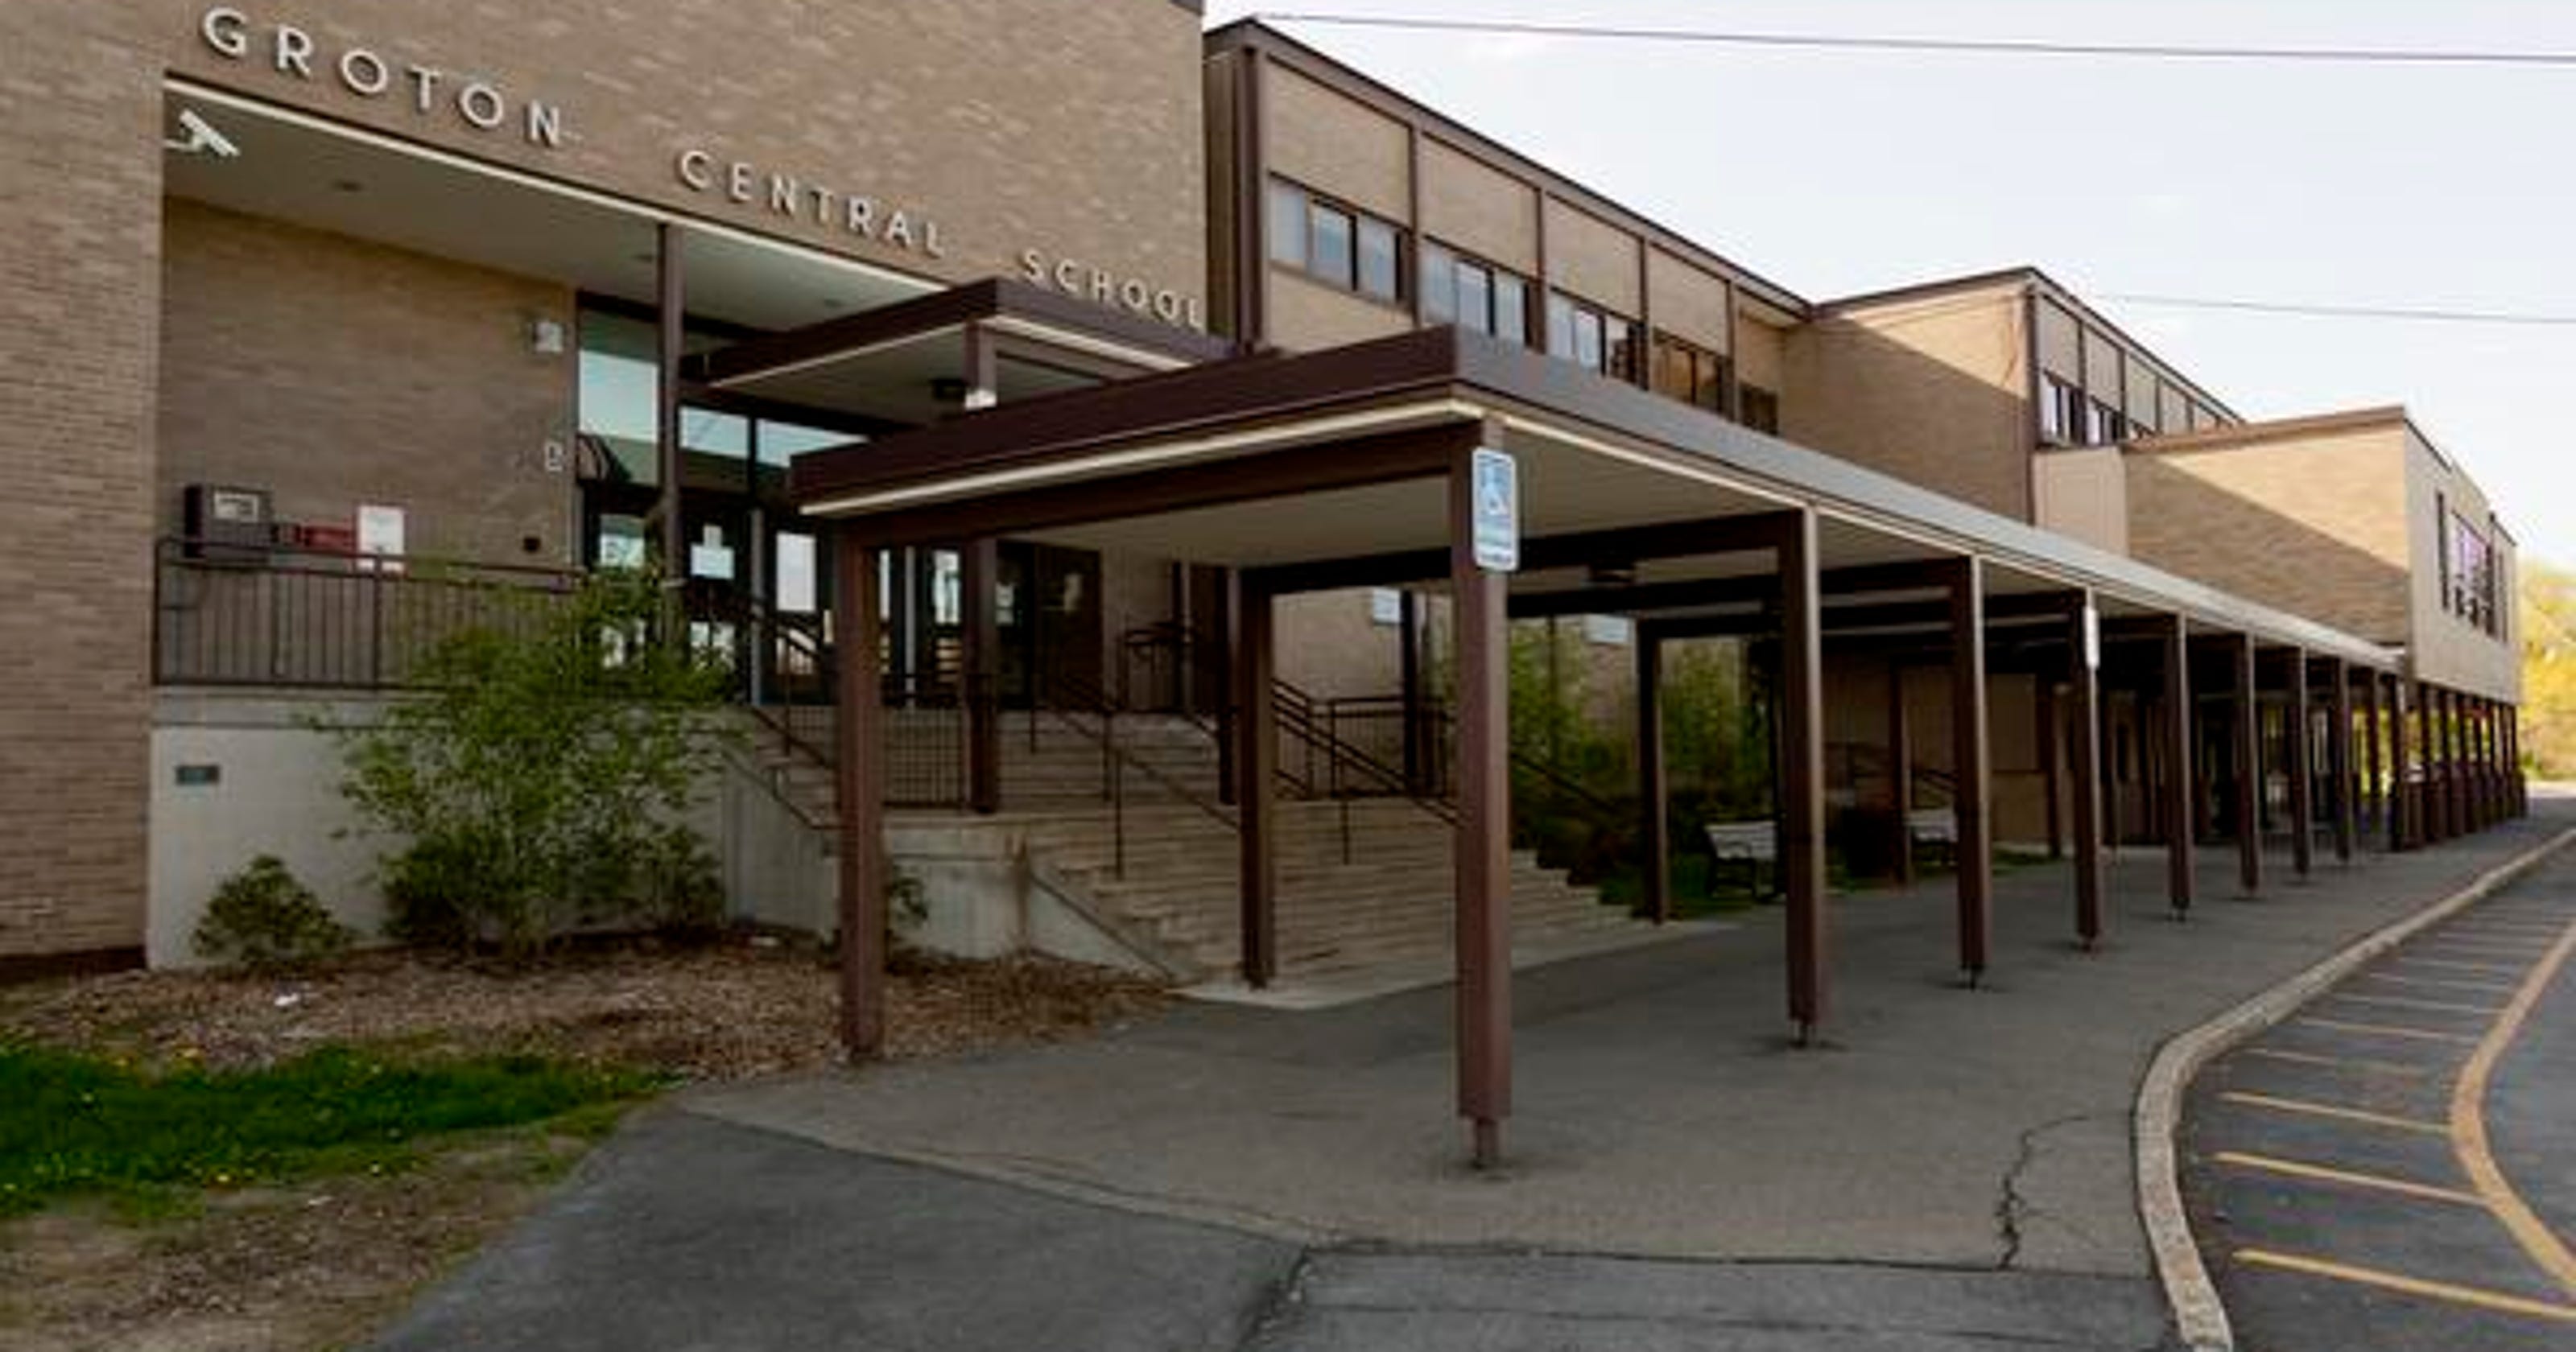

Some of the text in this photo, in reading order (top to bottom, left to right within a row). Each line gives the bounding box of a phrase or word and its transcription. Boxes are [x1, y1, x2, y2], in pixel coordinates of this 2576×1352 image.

[203, 7, 1204, 328] GROTON CENTRAL SCHOOL
